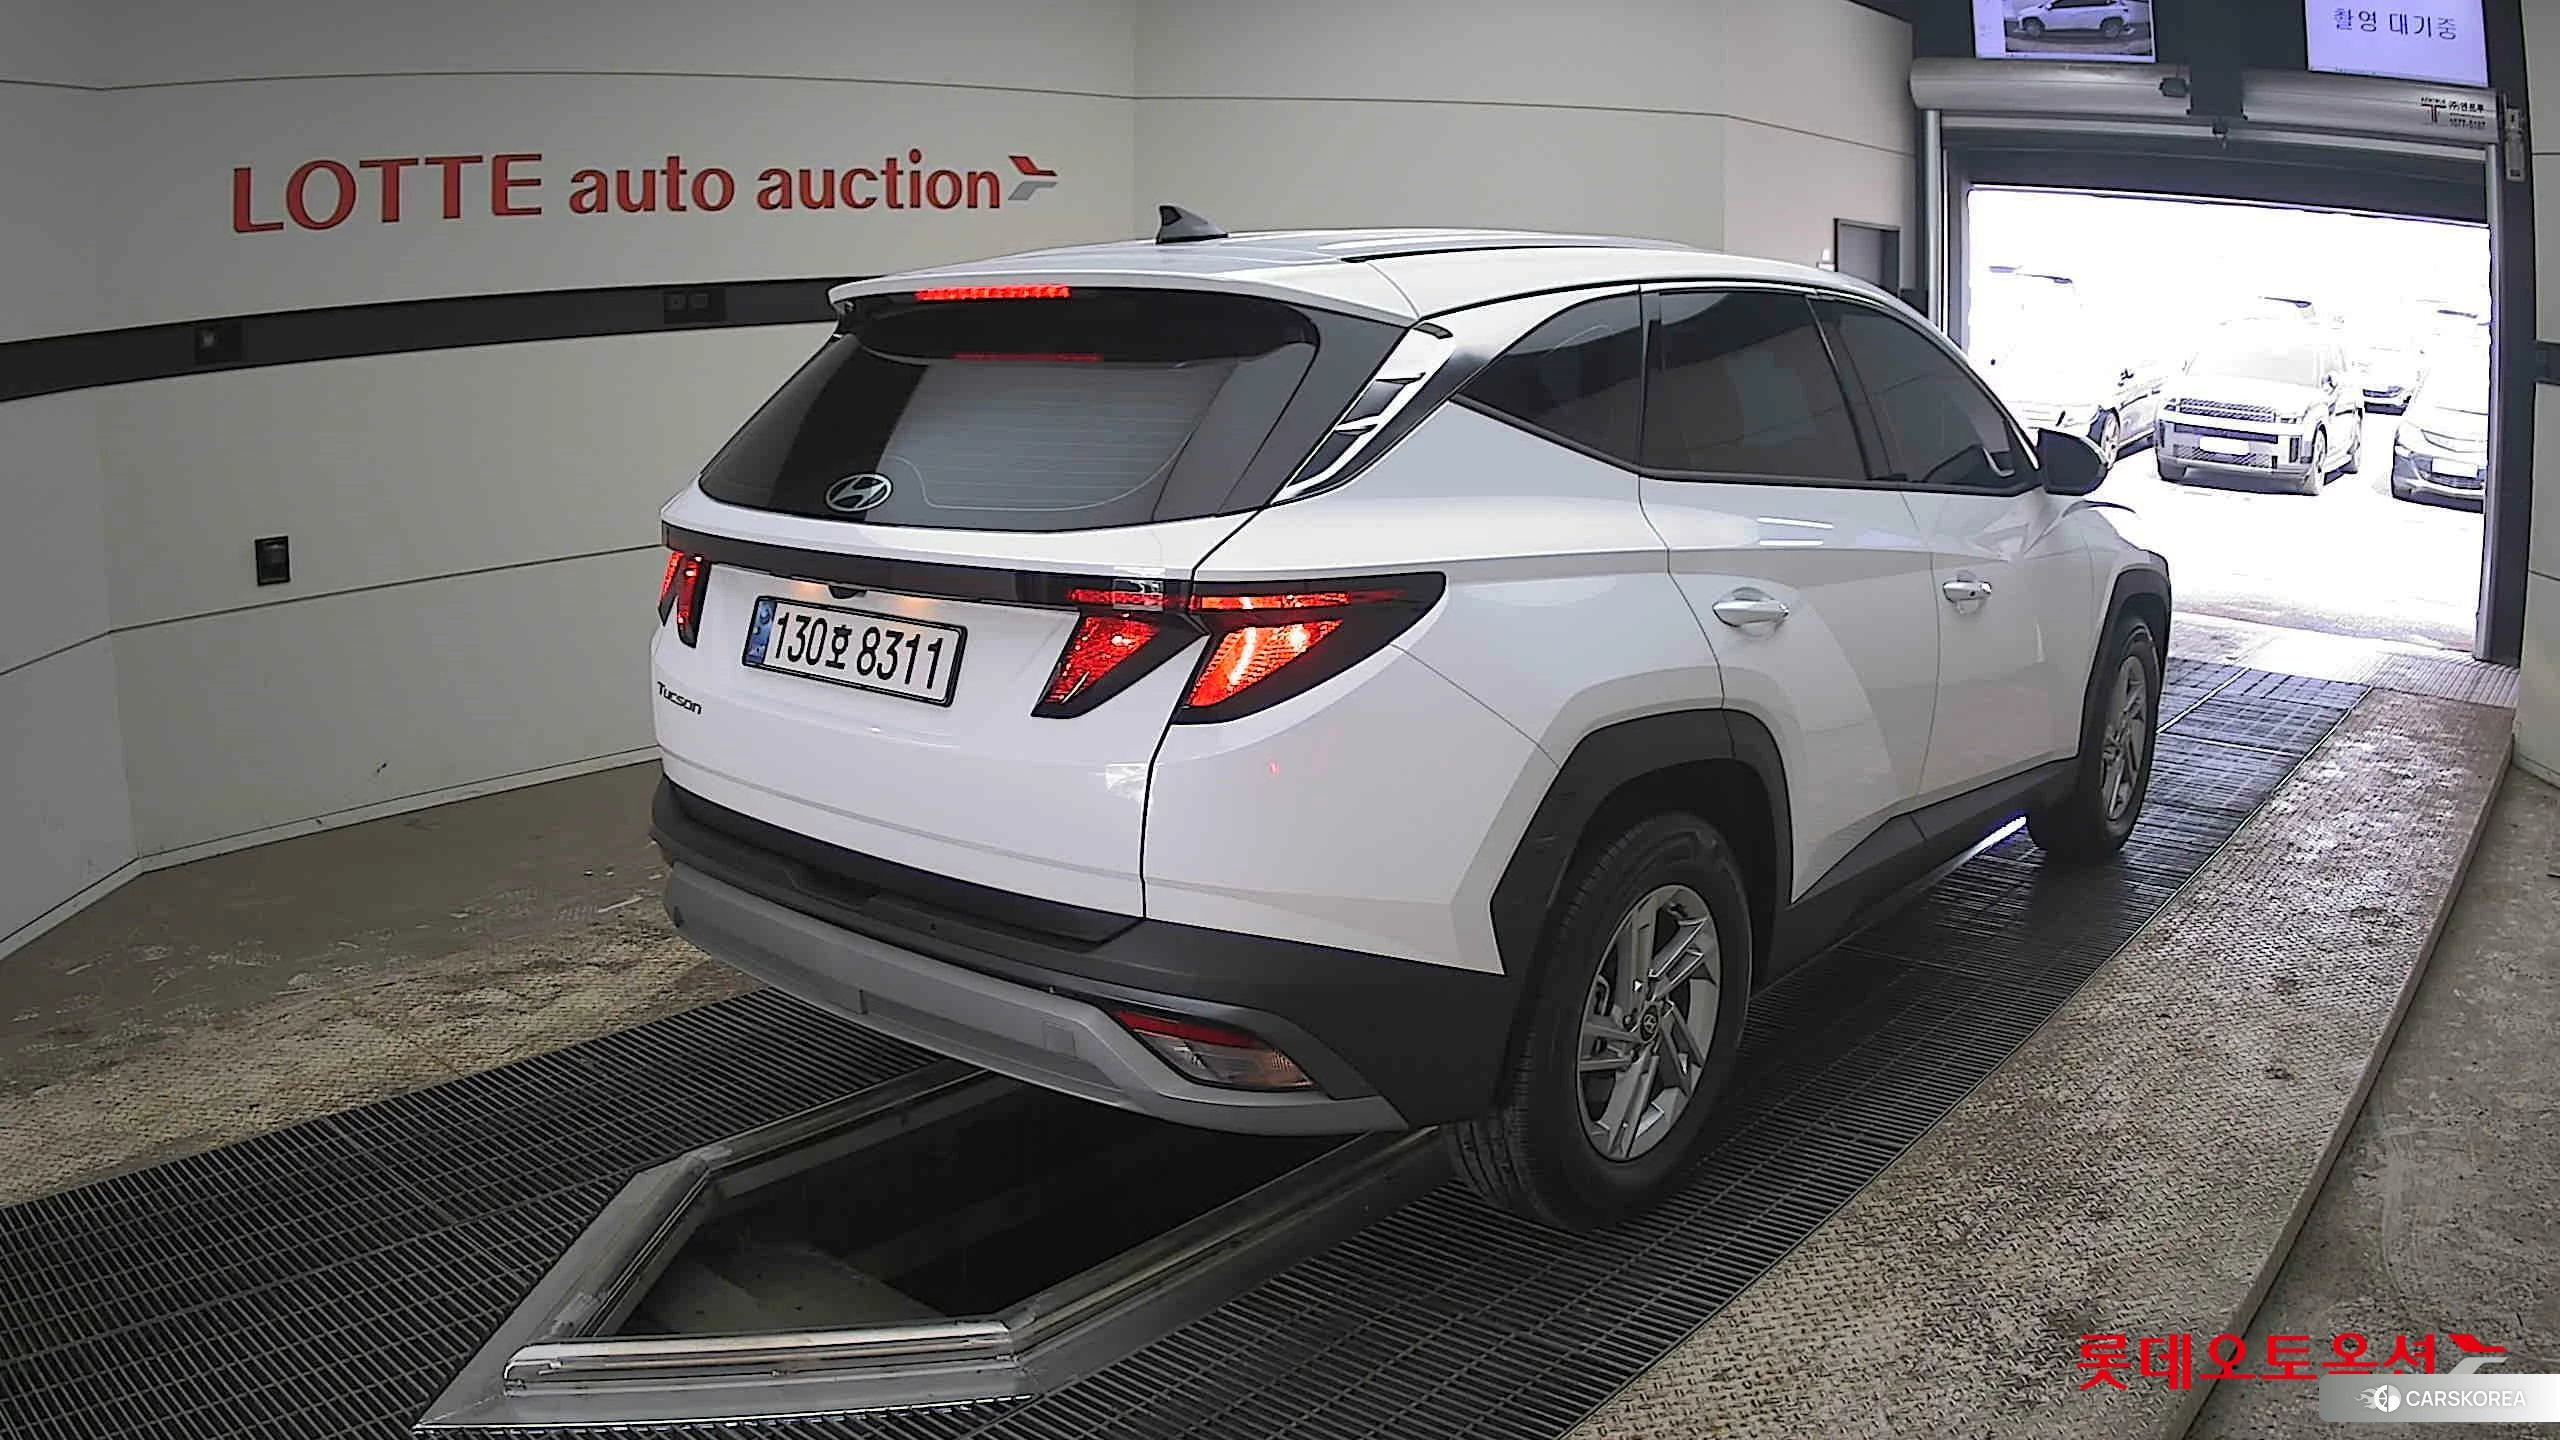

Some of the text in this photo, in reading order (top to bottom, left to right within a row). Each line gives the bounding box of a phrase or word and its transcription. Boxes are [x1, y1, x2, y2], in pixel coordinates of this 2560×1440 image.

[2334, 8, 2457, 40] 촬영 대기중
[234, 148, 1001, 233] LOTTE auto auction
[856, 626, 944, 690] 8311
